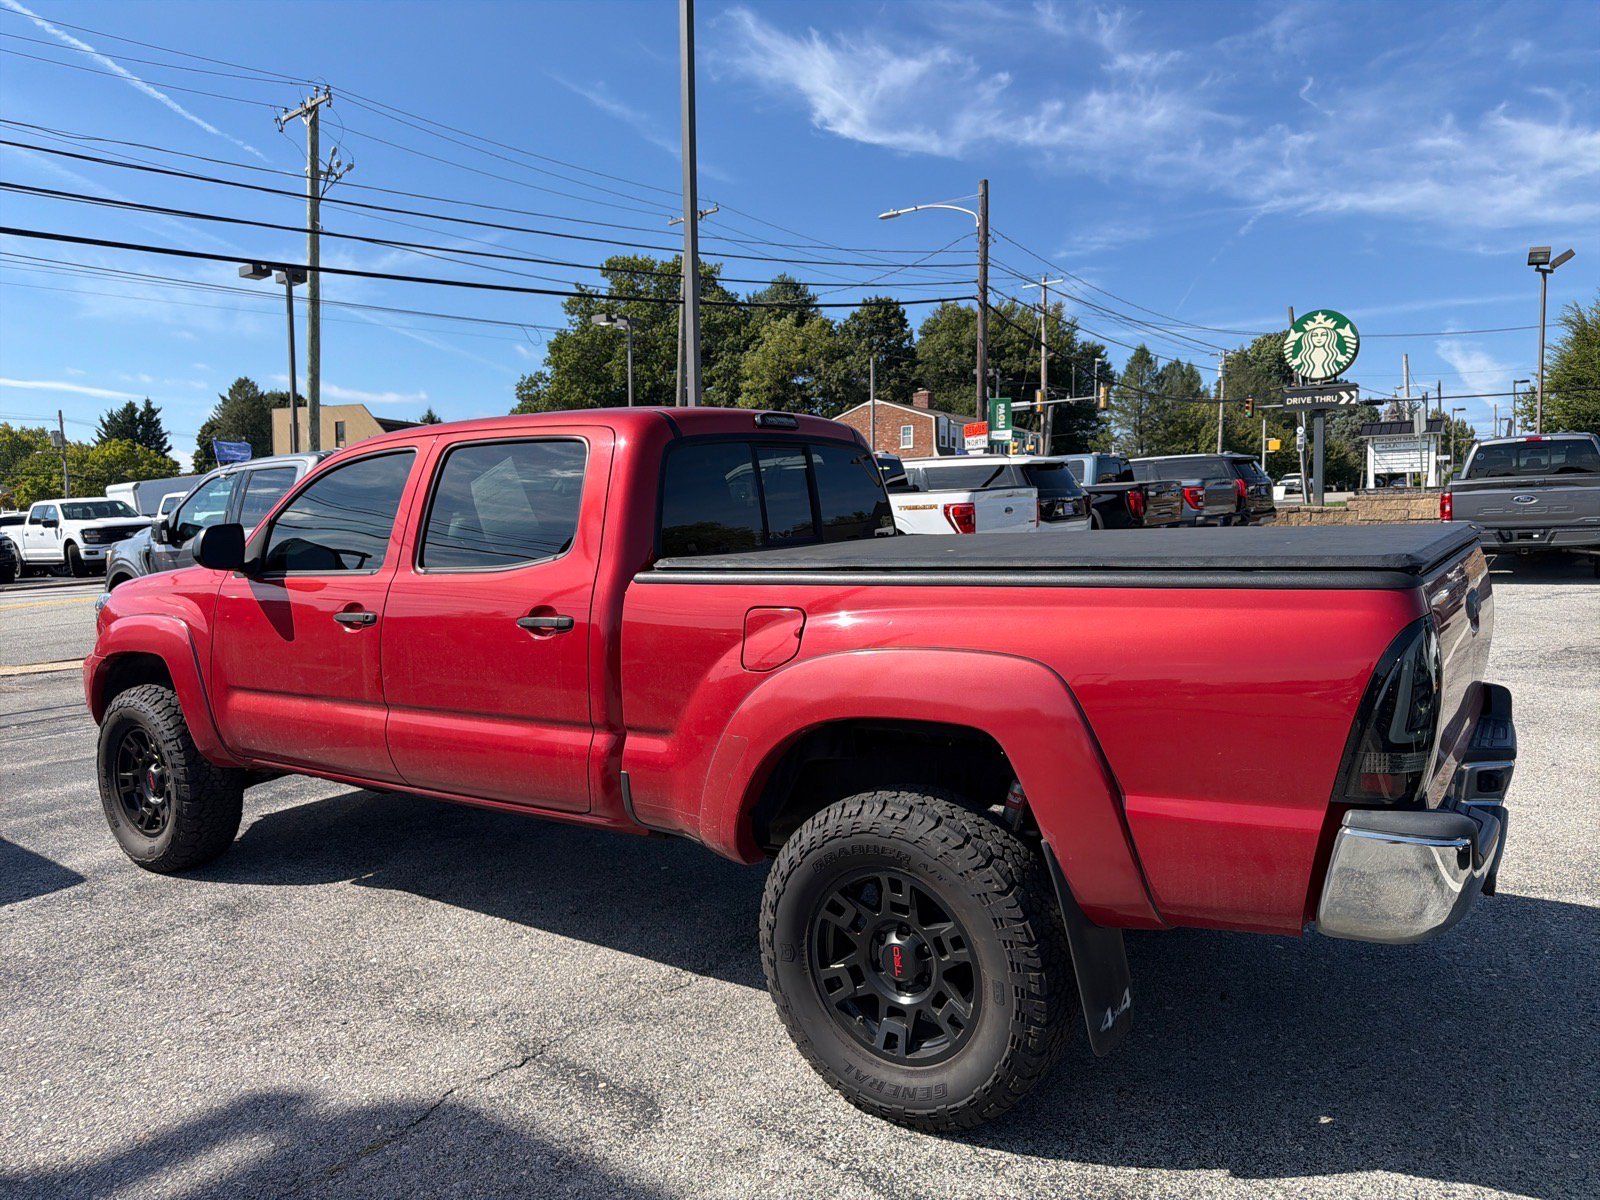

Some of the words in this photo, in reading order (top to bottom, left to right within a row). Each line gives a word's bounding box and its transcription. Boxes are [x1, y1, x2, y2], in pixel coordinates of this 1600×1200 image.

[1286, 396, 1312, 405] DRIVE
[1314, 395, 1338, 403] THRU
[998, 403, 1006, 429] PAOLI
[966, 438, 986, 446] NORTH
[893, 946, 903, 977] TRD
[843, 1058, 948, 1102] GENERAL
